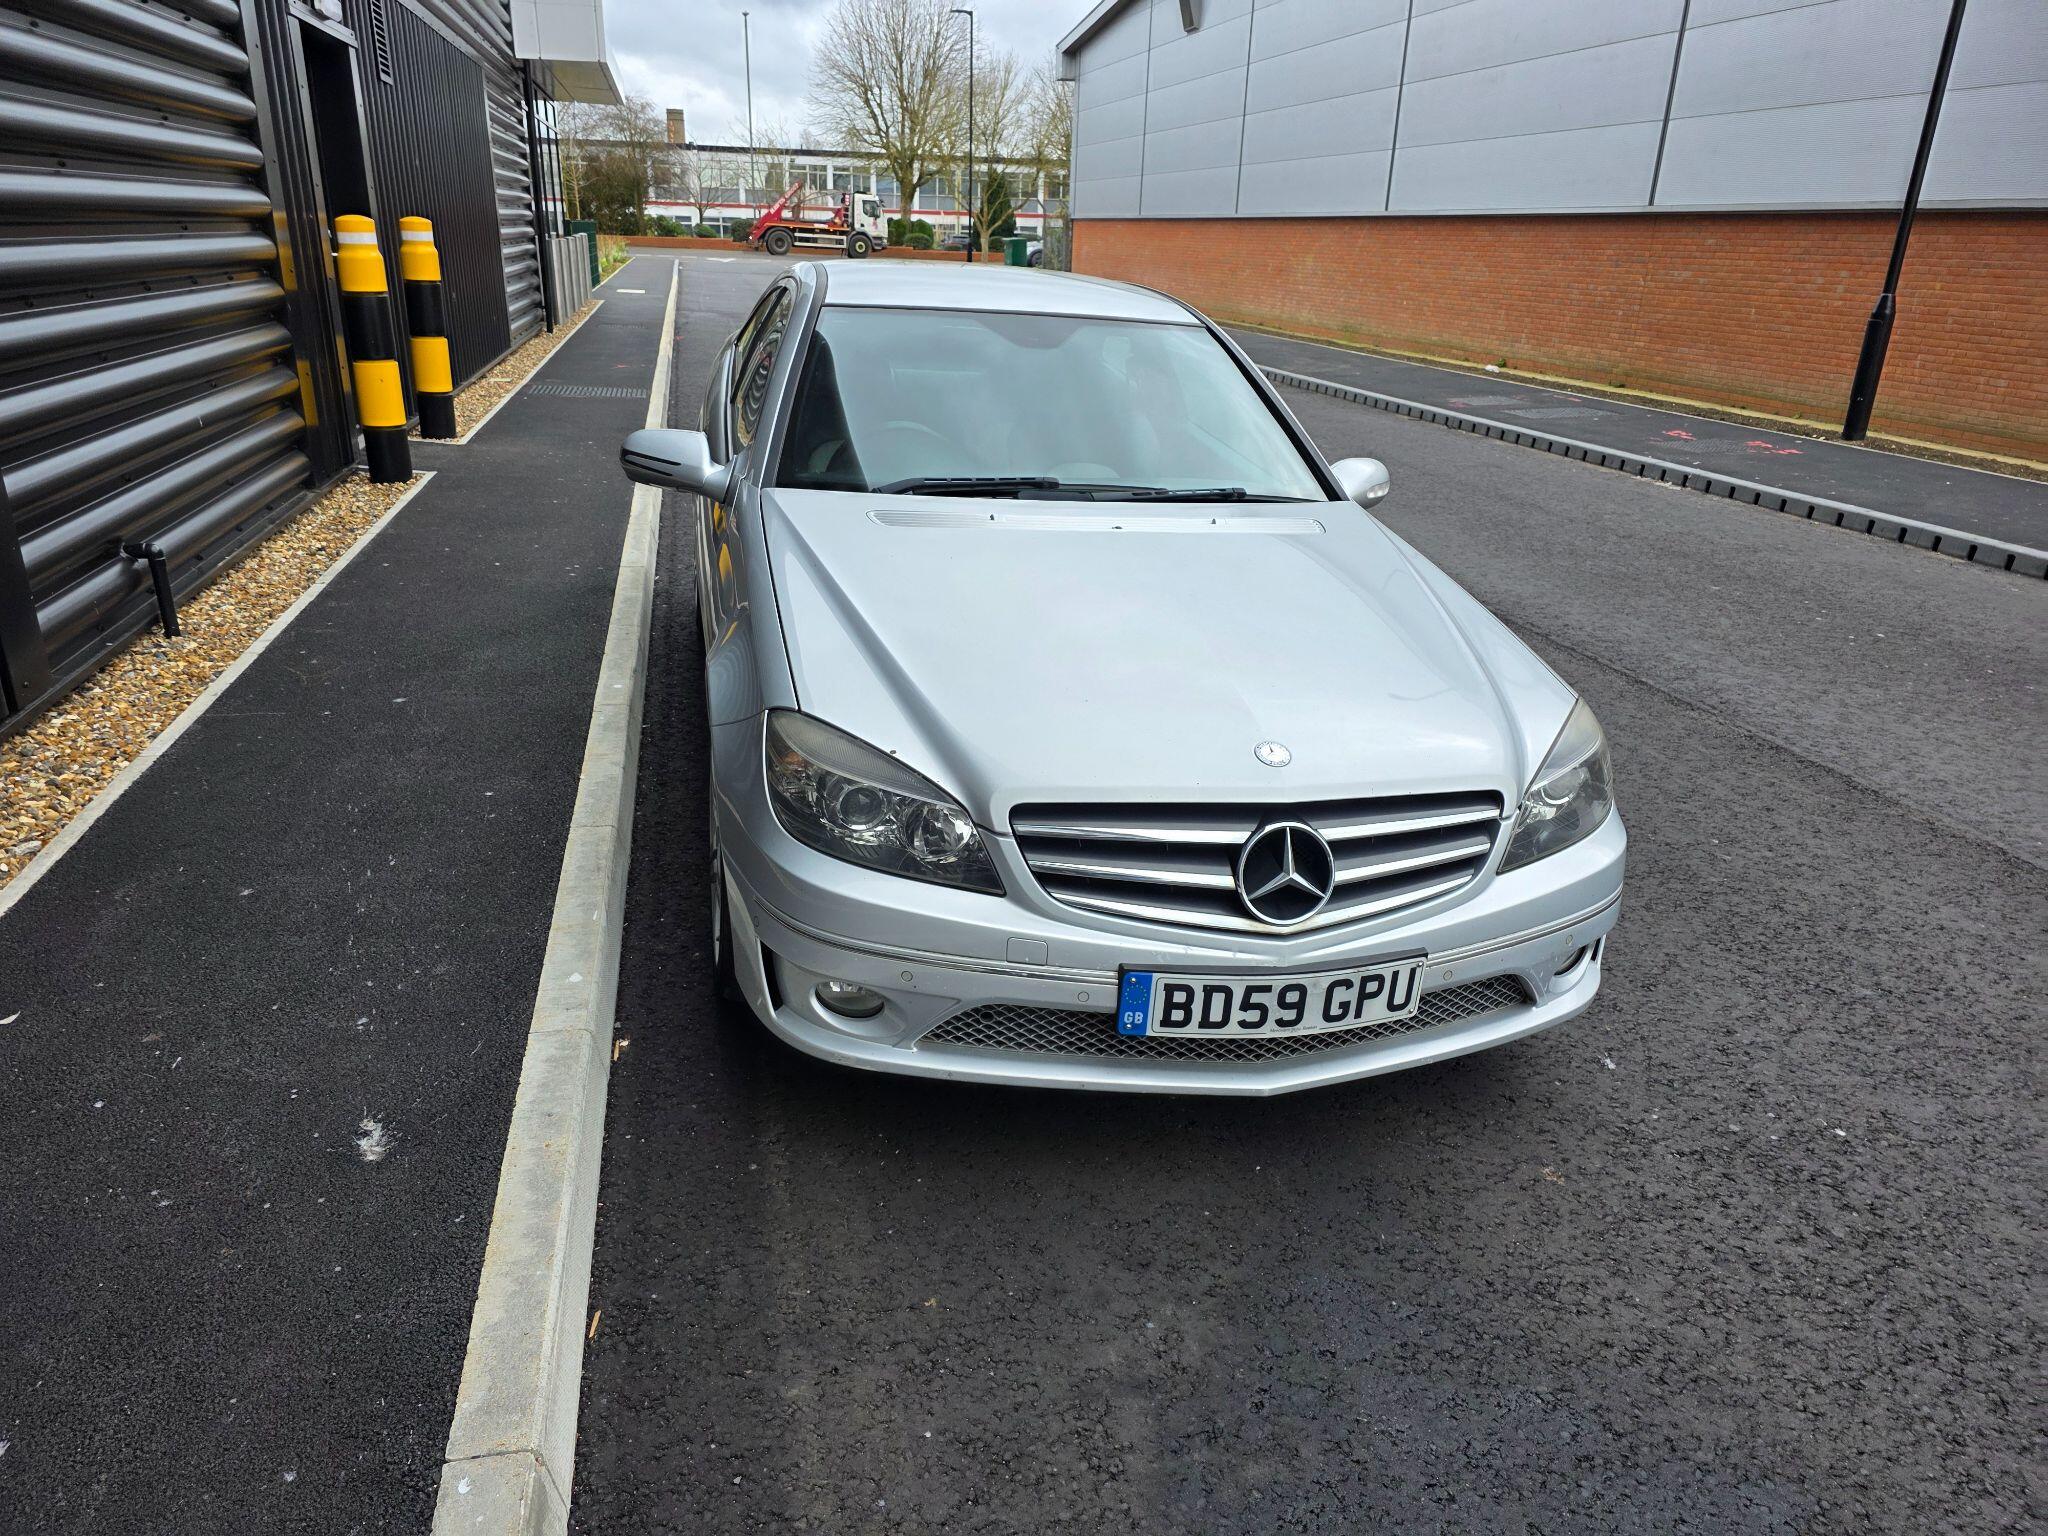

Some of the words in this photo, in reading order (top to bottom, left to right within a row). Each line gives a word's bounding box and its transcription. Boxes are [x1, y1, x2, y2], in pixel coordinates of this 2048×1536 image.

[1159, 982, 1309, 1030] BD59
[1321, 966, 1418, 1024] GPU
[1123, 1011, 1144, 1024] GB
